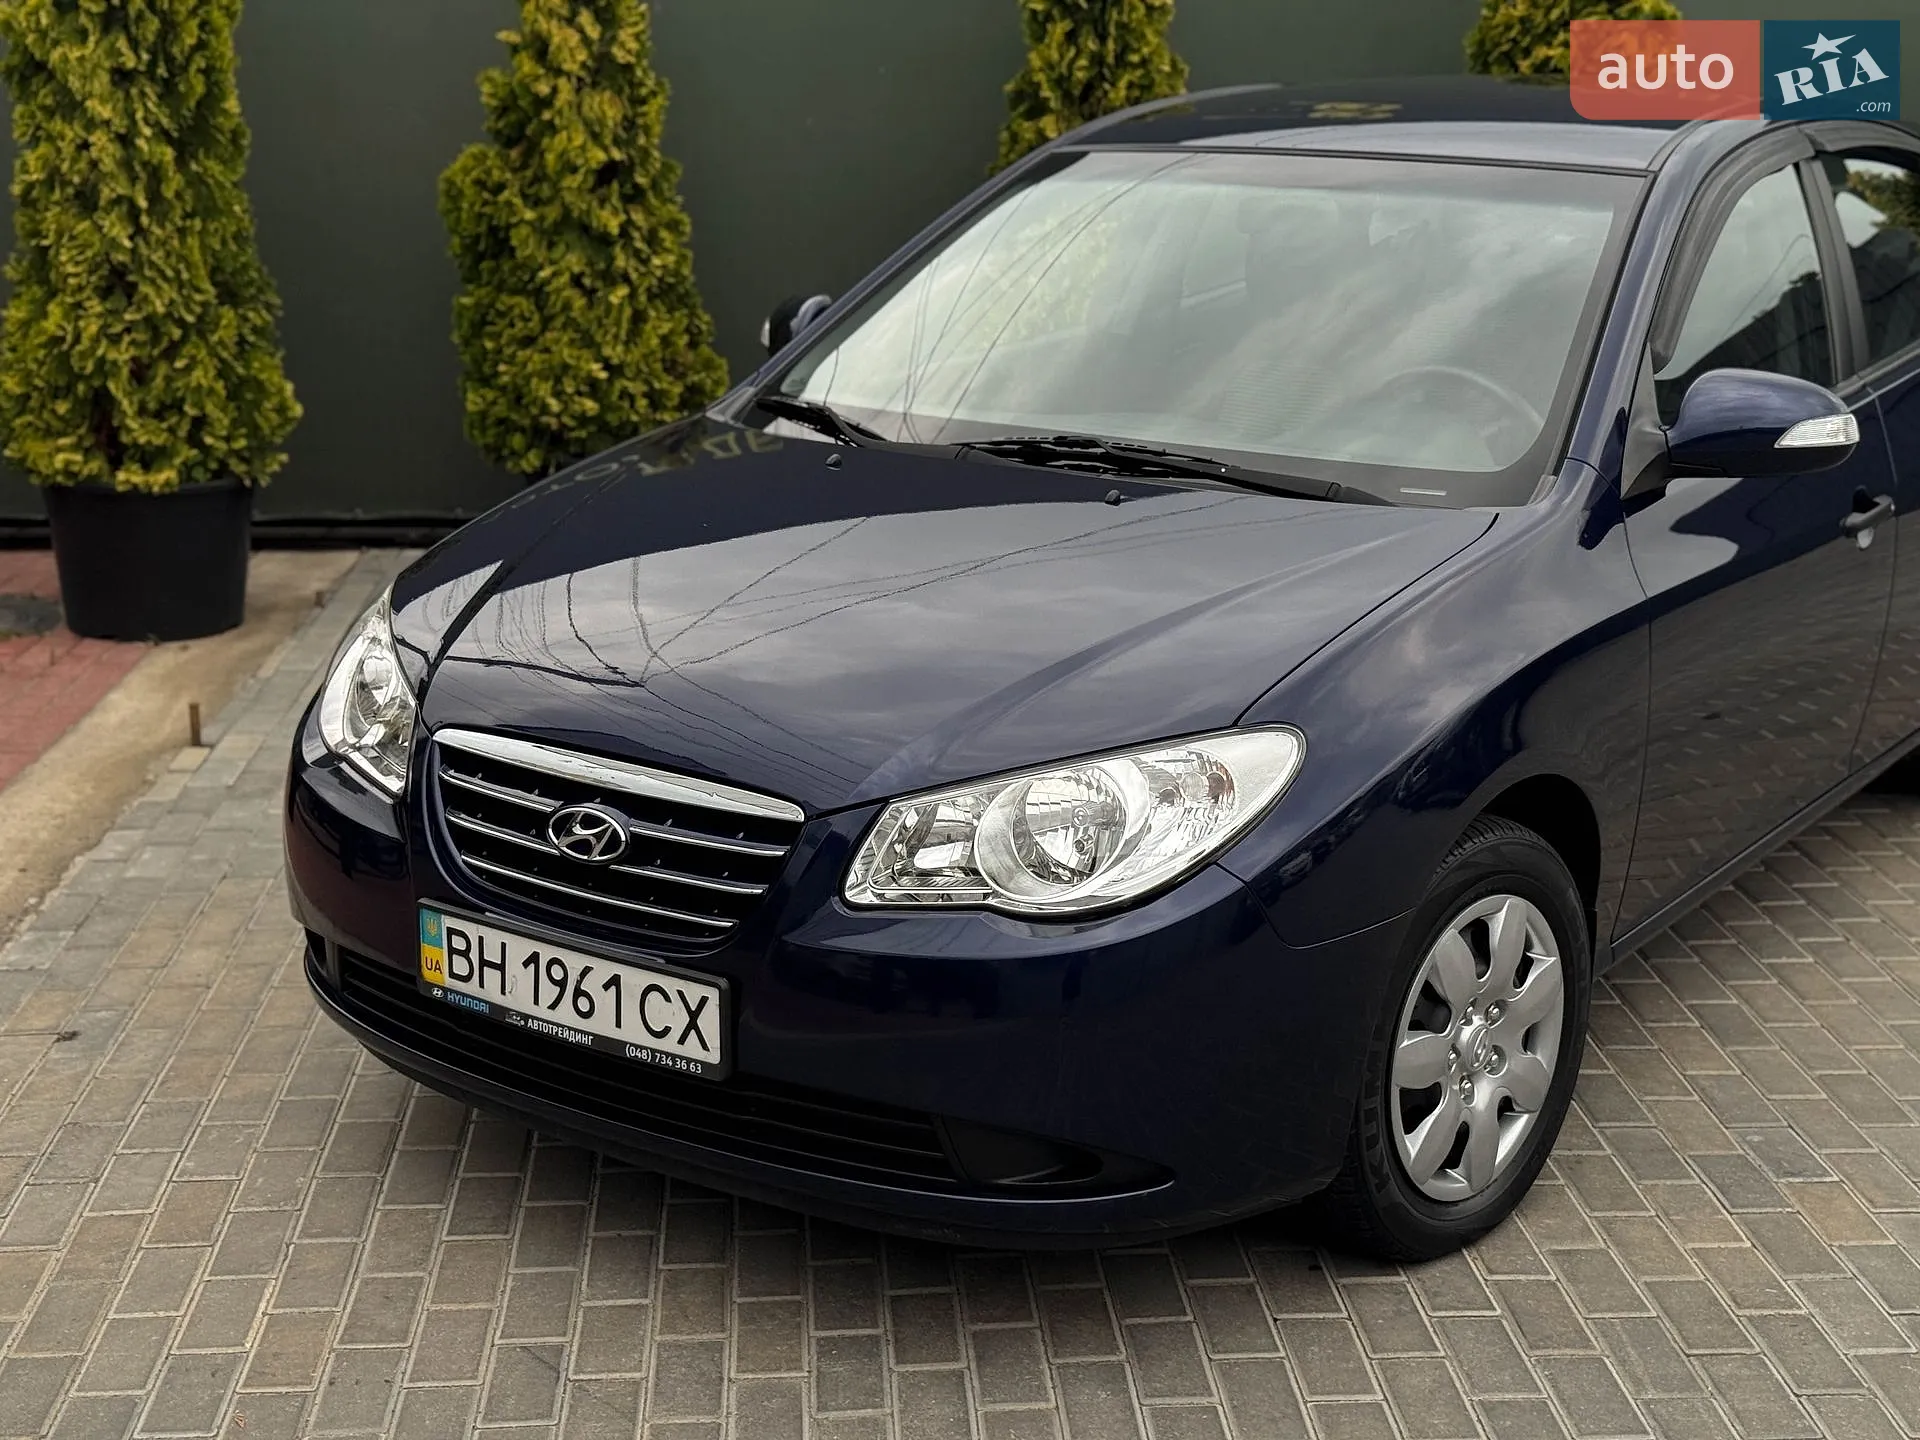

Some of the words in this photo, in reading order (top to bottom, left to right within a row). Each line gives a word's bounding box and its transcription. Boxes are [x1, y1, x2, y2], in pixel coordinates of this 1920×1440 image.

[425, 955, 443, 975] UA
[446, 926, 507, 997] BH
[521, 950, 622, 1030] 1961
[639, 982, 711, 1052] CX
[447, 991, 490, 1014] HYUNDAI
[527, 1017, 595, 1046] АВТОТРЕЙДИНГ
[625, 1043, 652, 1062] (048)
[655, 1052, 673, 1067] 734
[675, 1058, 688, 1070] 36
[689, 1062, 702, 1074] 63
